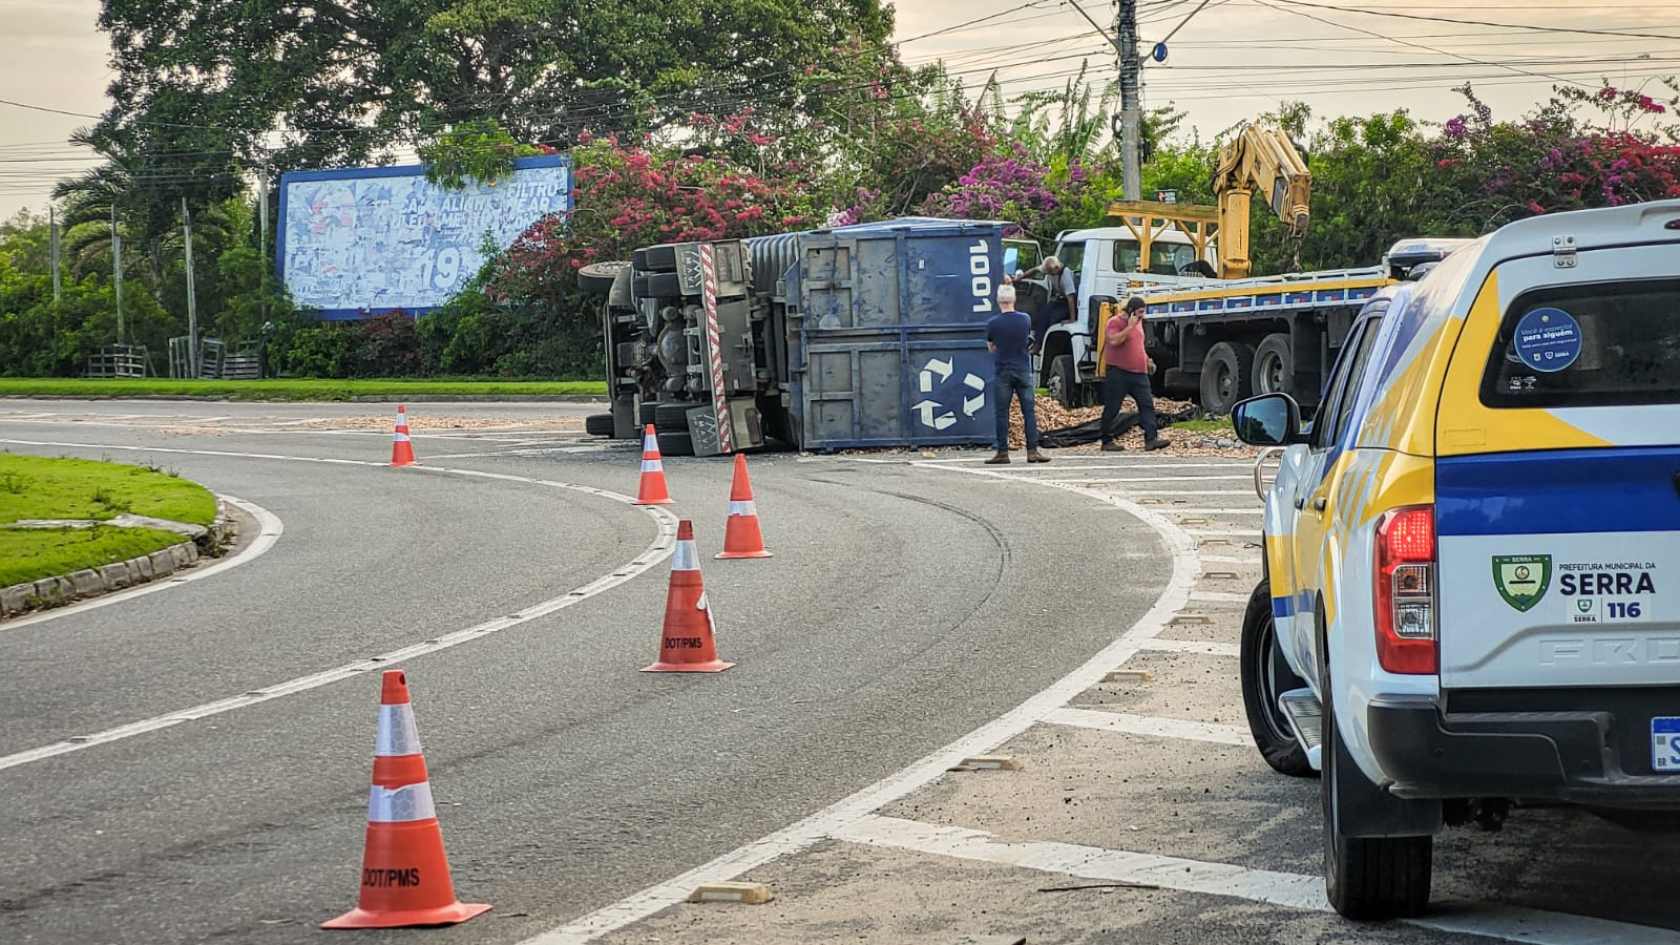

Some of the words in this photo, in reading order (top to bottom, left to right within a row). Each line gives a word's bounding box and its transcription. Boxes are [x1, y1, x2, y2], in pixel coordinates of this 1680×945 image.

[969, 239, 993, 313] 1001
[1523, 334, 1541, 342] para
[1543, 330, 1573, 338] alguém
[1559, 563, 1603, 571] PREFEITURA
[1605, 562, 1642, 570] MUNICIPAL
[1560, 572, 1656, 596] SERRA
[1607, 602, 1641, 618] 116
